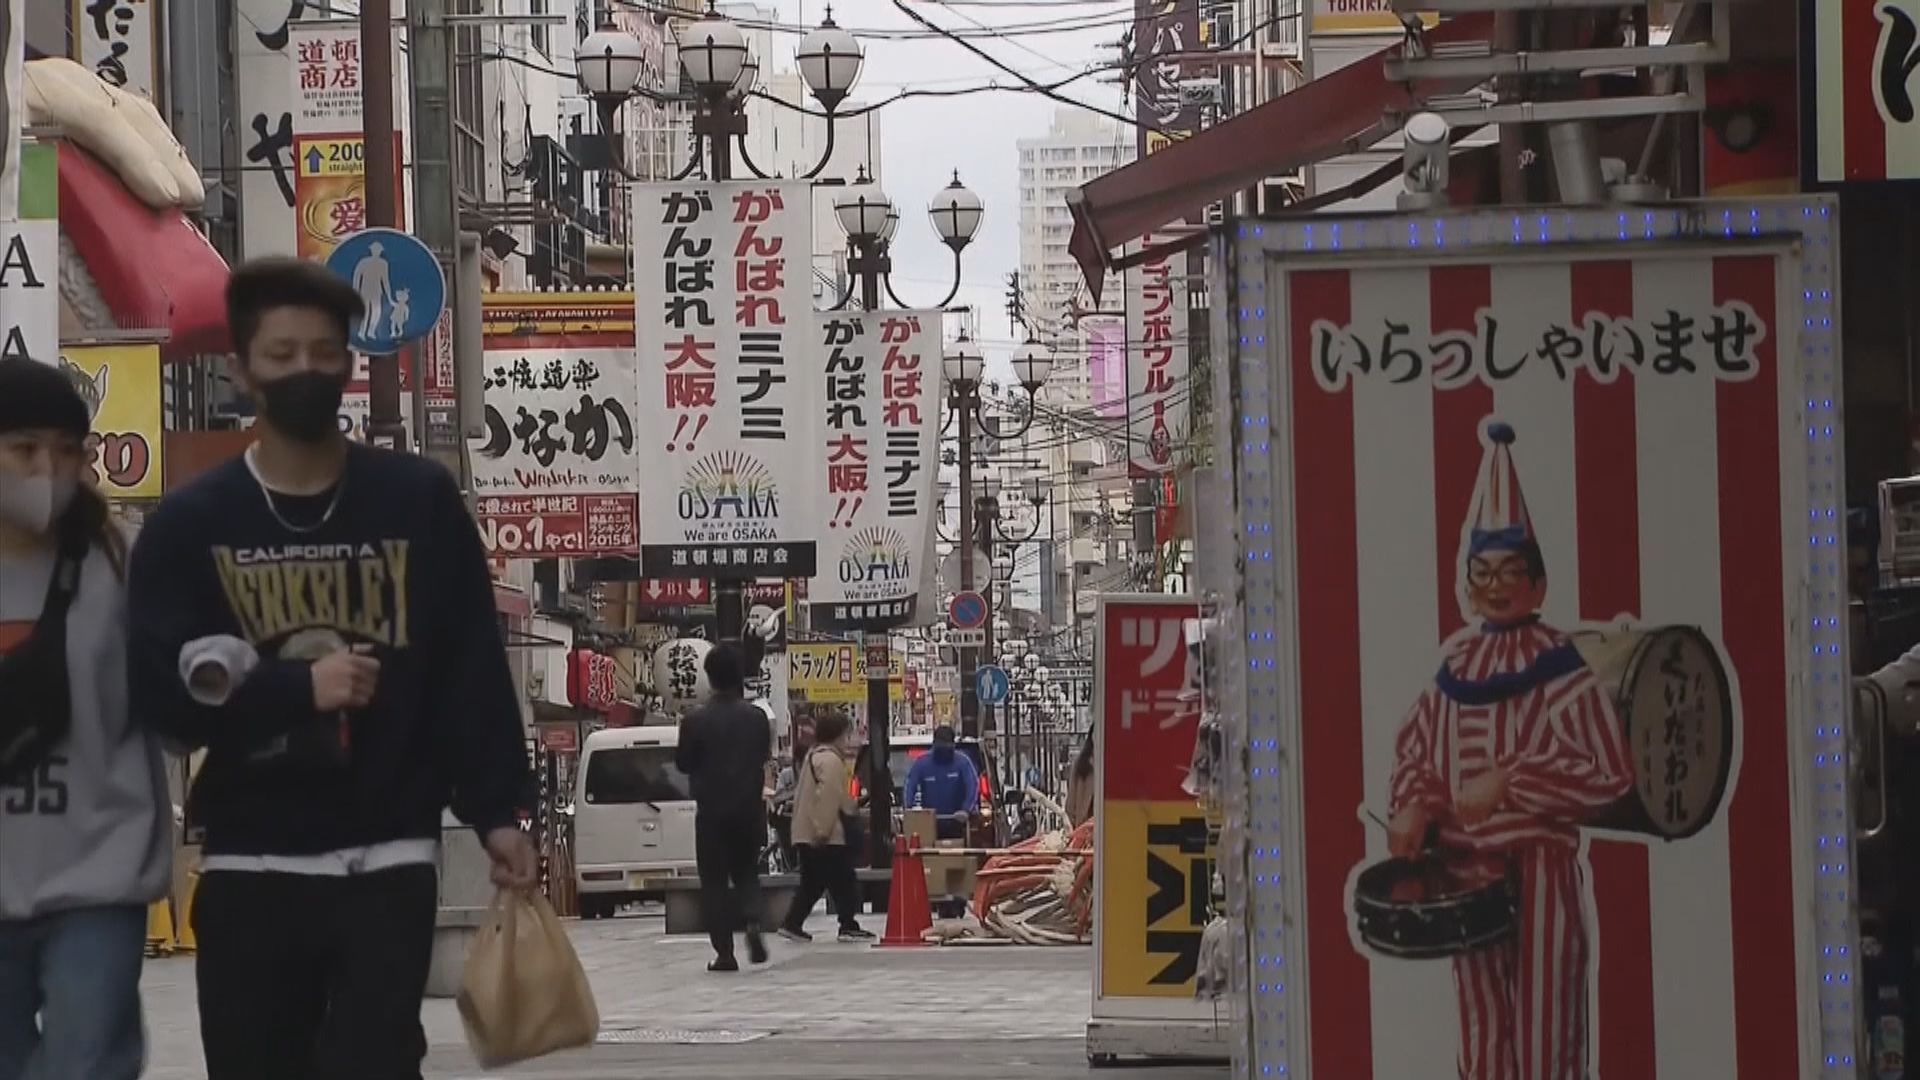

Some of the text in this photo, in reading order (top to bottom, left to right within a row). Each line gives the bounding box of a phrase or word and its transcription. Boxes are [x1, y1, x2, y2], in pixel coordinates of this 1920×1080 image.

[732, 189, 786, 440] がんばれミナミ
[1317, 308, 1757, 383] いらっしゃいませ
[880, 317, 923, 517] がんばれミナミ
[679, 467, 779, 519] OSAKA
[236, 544, 376, 563] CALIFORNIA
[685, 528, 777, 541] We are OSAKA
[844, 590, 860, 600] We
[863, 590, 878, 599] are
[791, 651, 838, 679] ドラッグ
